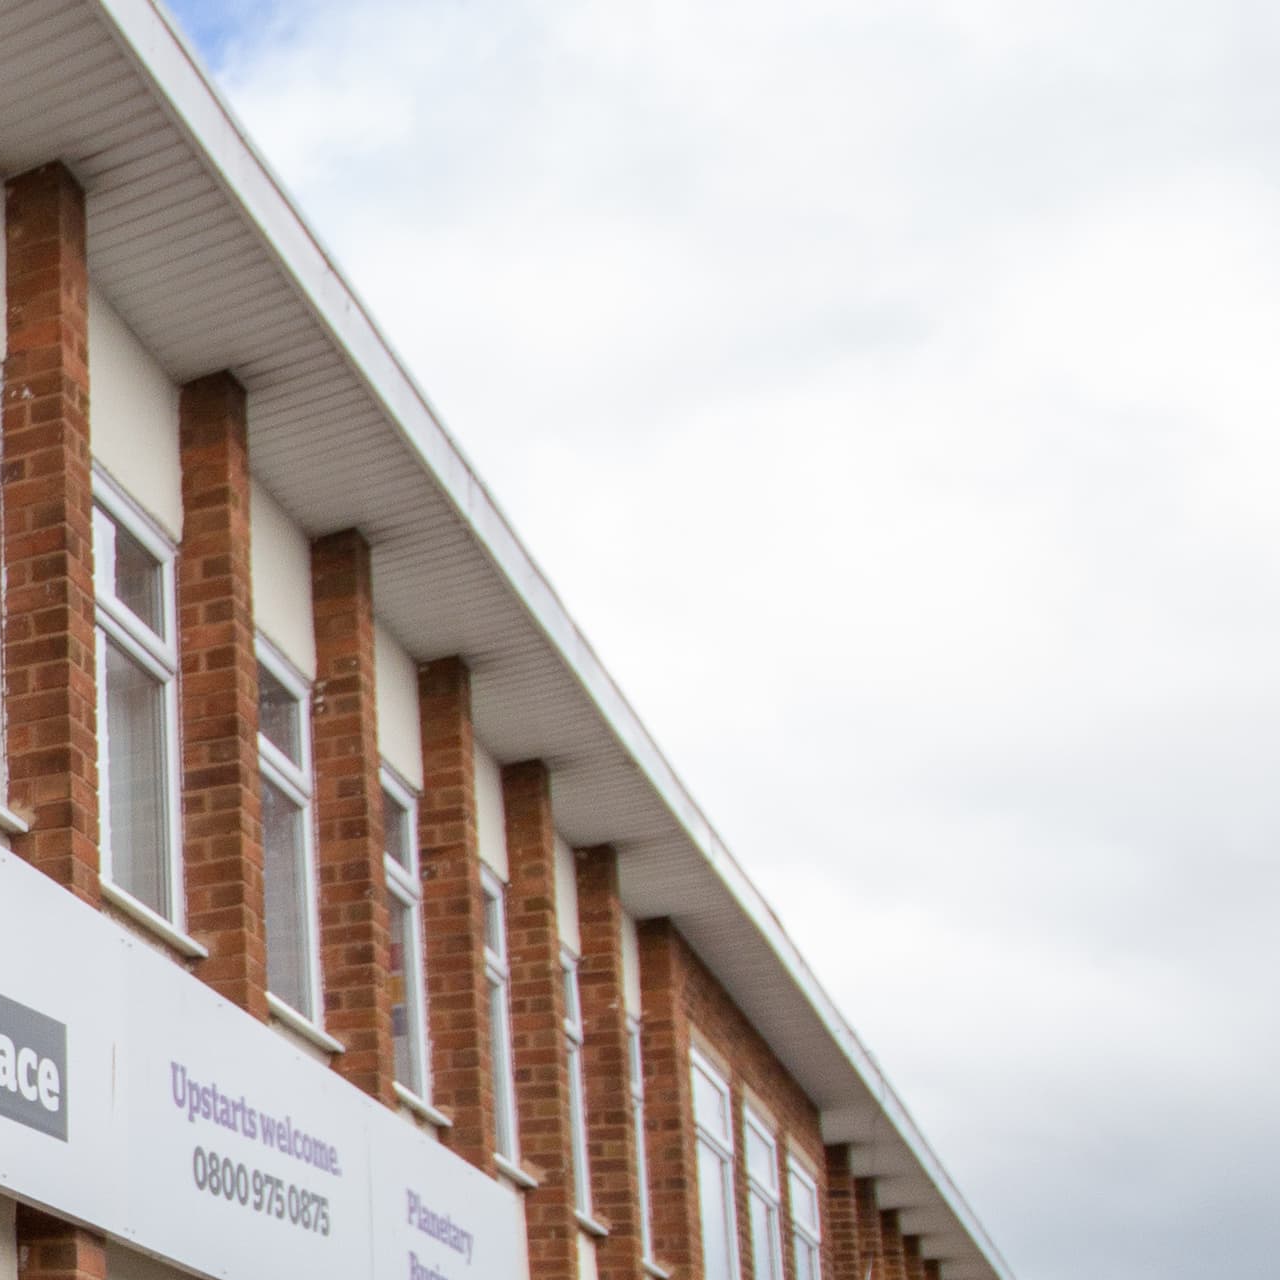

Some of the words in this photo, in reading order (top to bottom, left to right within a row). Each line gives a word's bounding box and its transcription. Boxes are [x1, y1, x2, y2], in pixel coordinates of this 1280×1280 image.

[171, 1061, 258, 1140] Upstarts
[259, 1112, 342, 1177] welcome.
[193, 1146, 249, 1206] 0800
[253, 1169, 285, 1220] 975
[288, 1184, 331, 1237] 0875
[407, 1187, 474, 1265] Planetary
